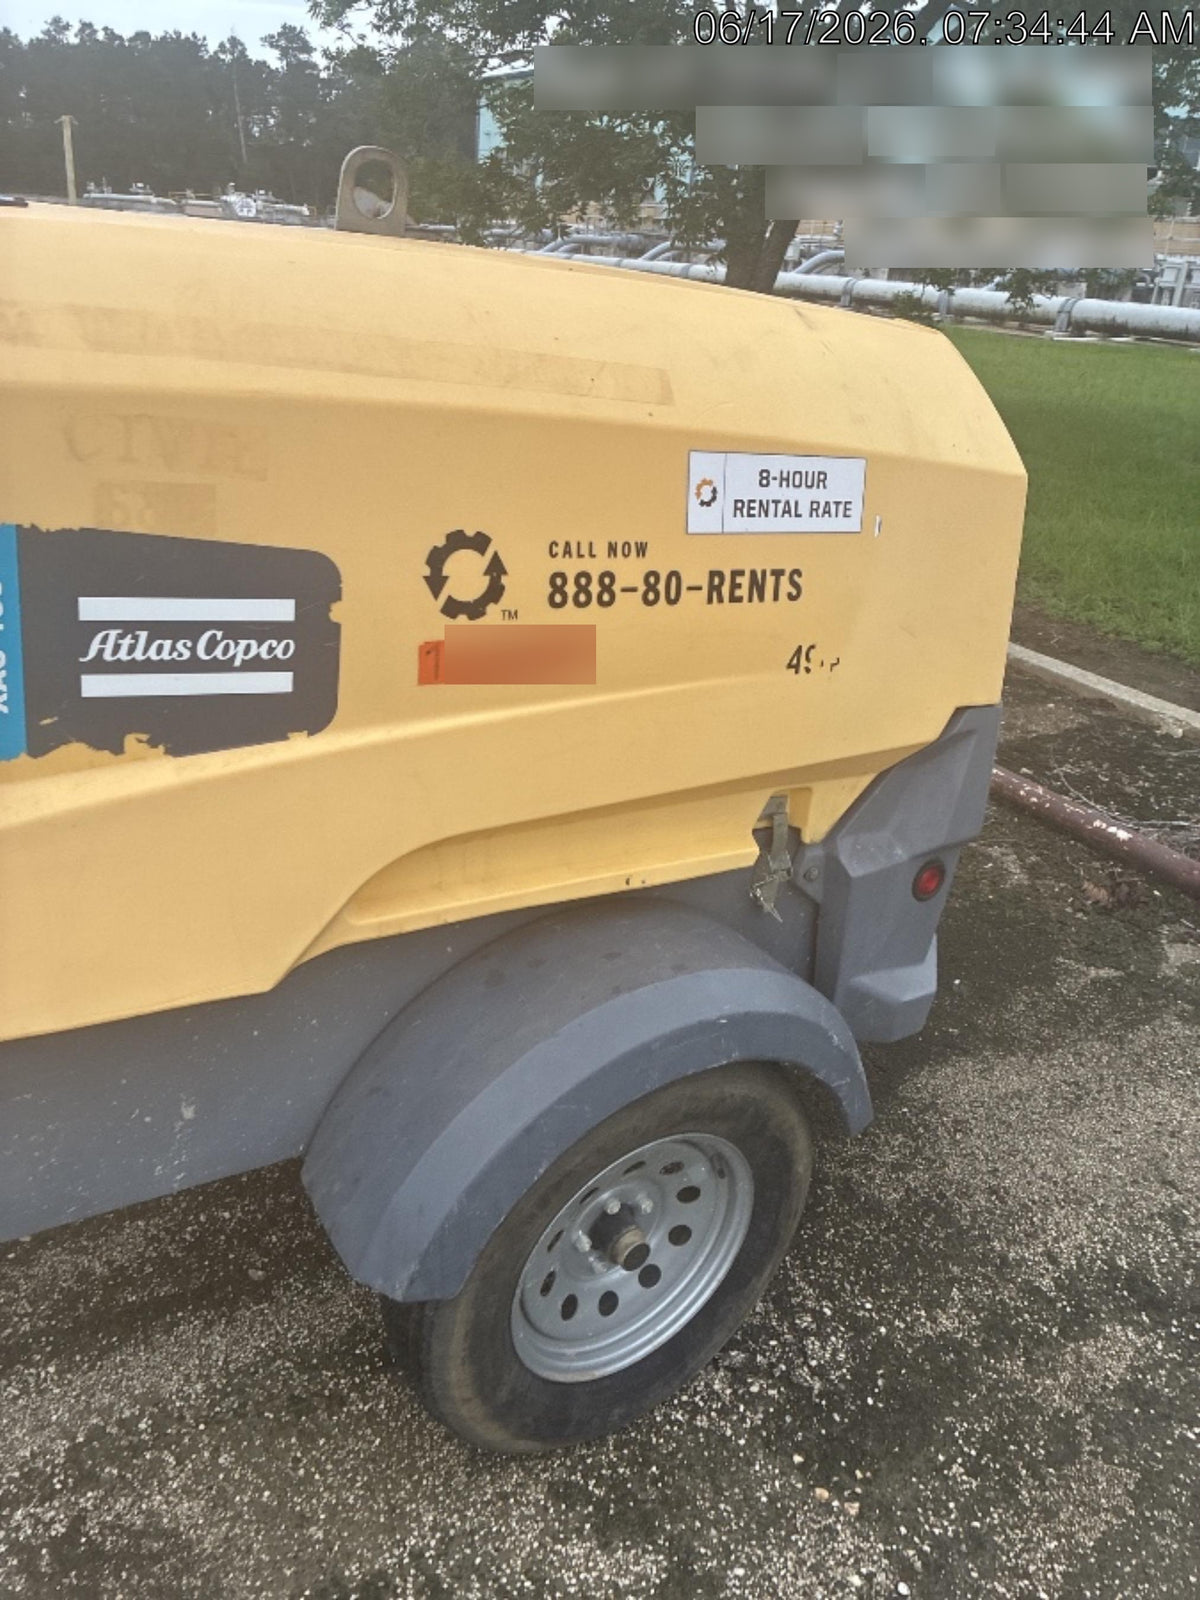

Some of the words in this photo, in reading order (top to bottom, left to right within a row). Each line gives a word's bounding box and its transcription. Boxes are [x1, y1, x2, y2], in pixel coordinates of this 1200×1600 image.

[758, 469, 828, 490] 8-HOUR
[733, 499, 803, 518] RENTAL
[808, 500, 853, 519] RATE
[548, 540, 597, 559] CALL
[607, 540, 649, 559] NOW
[547, 568, 803, 609] 888-80-RENTS
[501, 608, 518, 621] TM
[78, 629, 192, 662] Atlas
[196, 629, 296, 667] Copco
